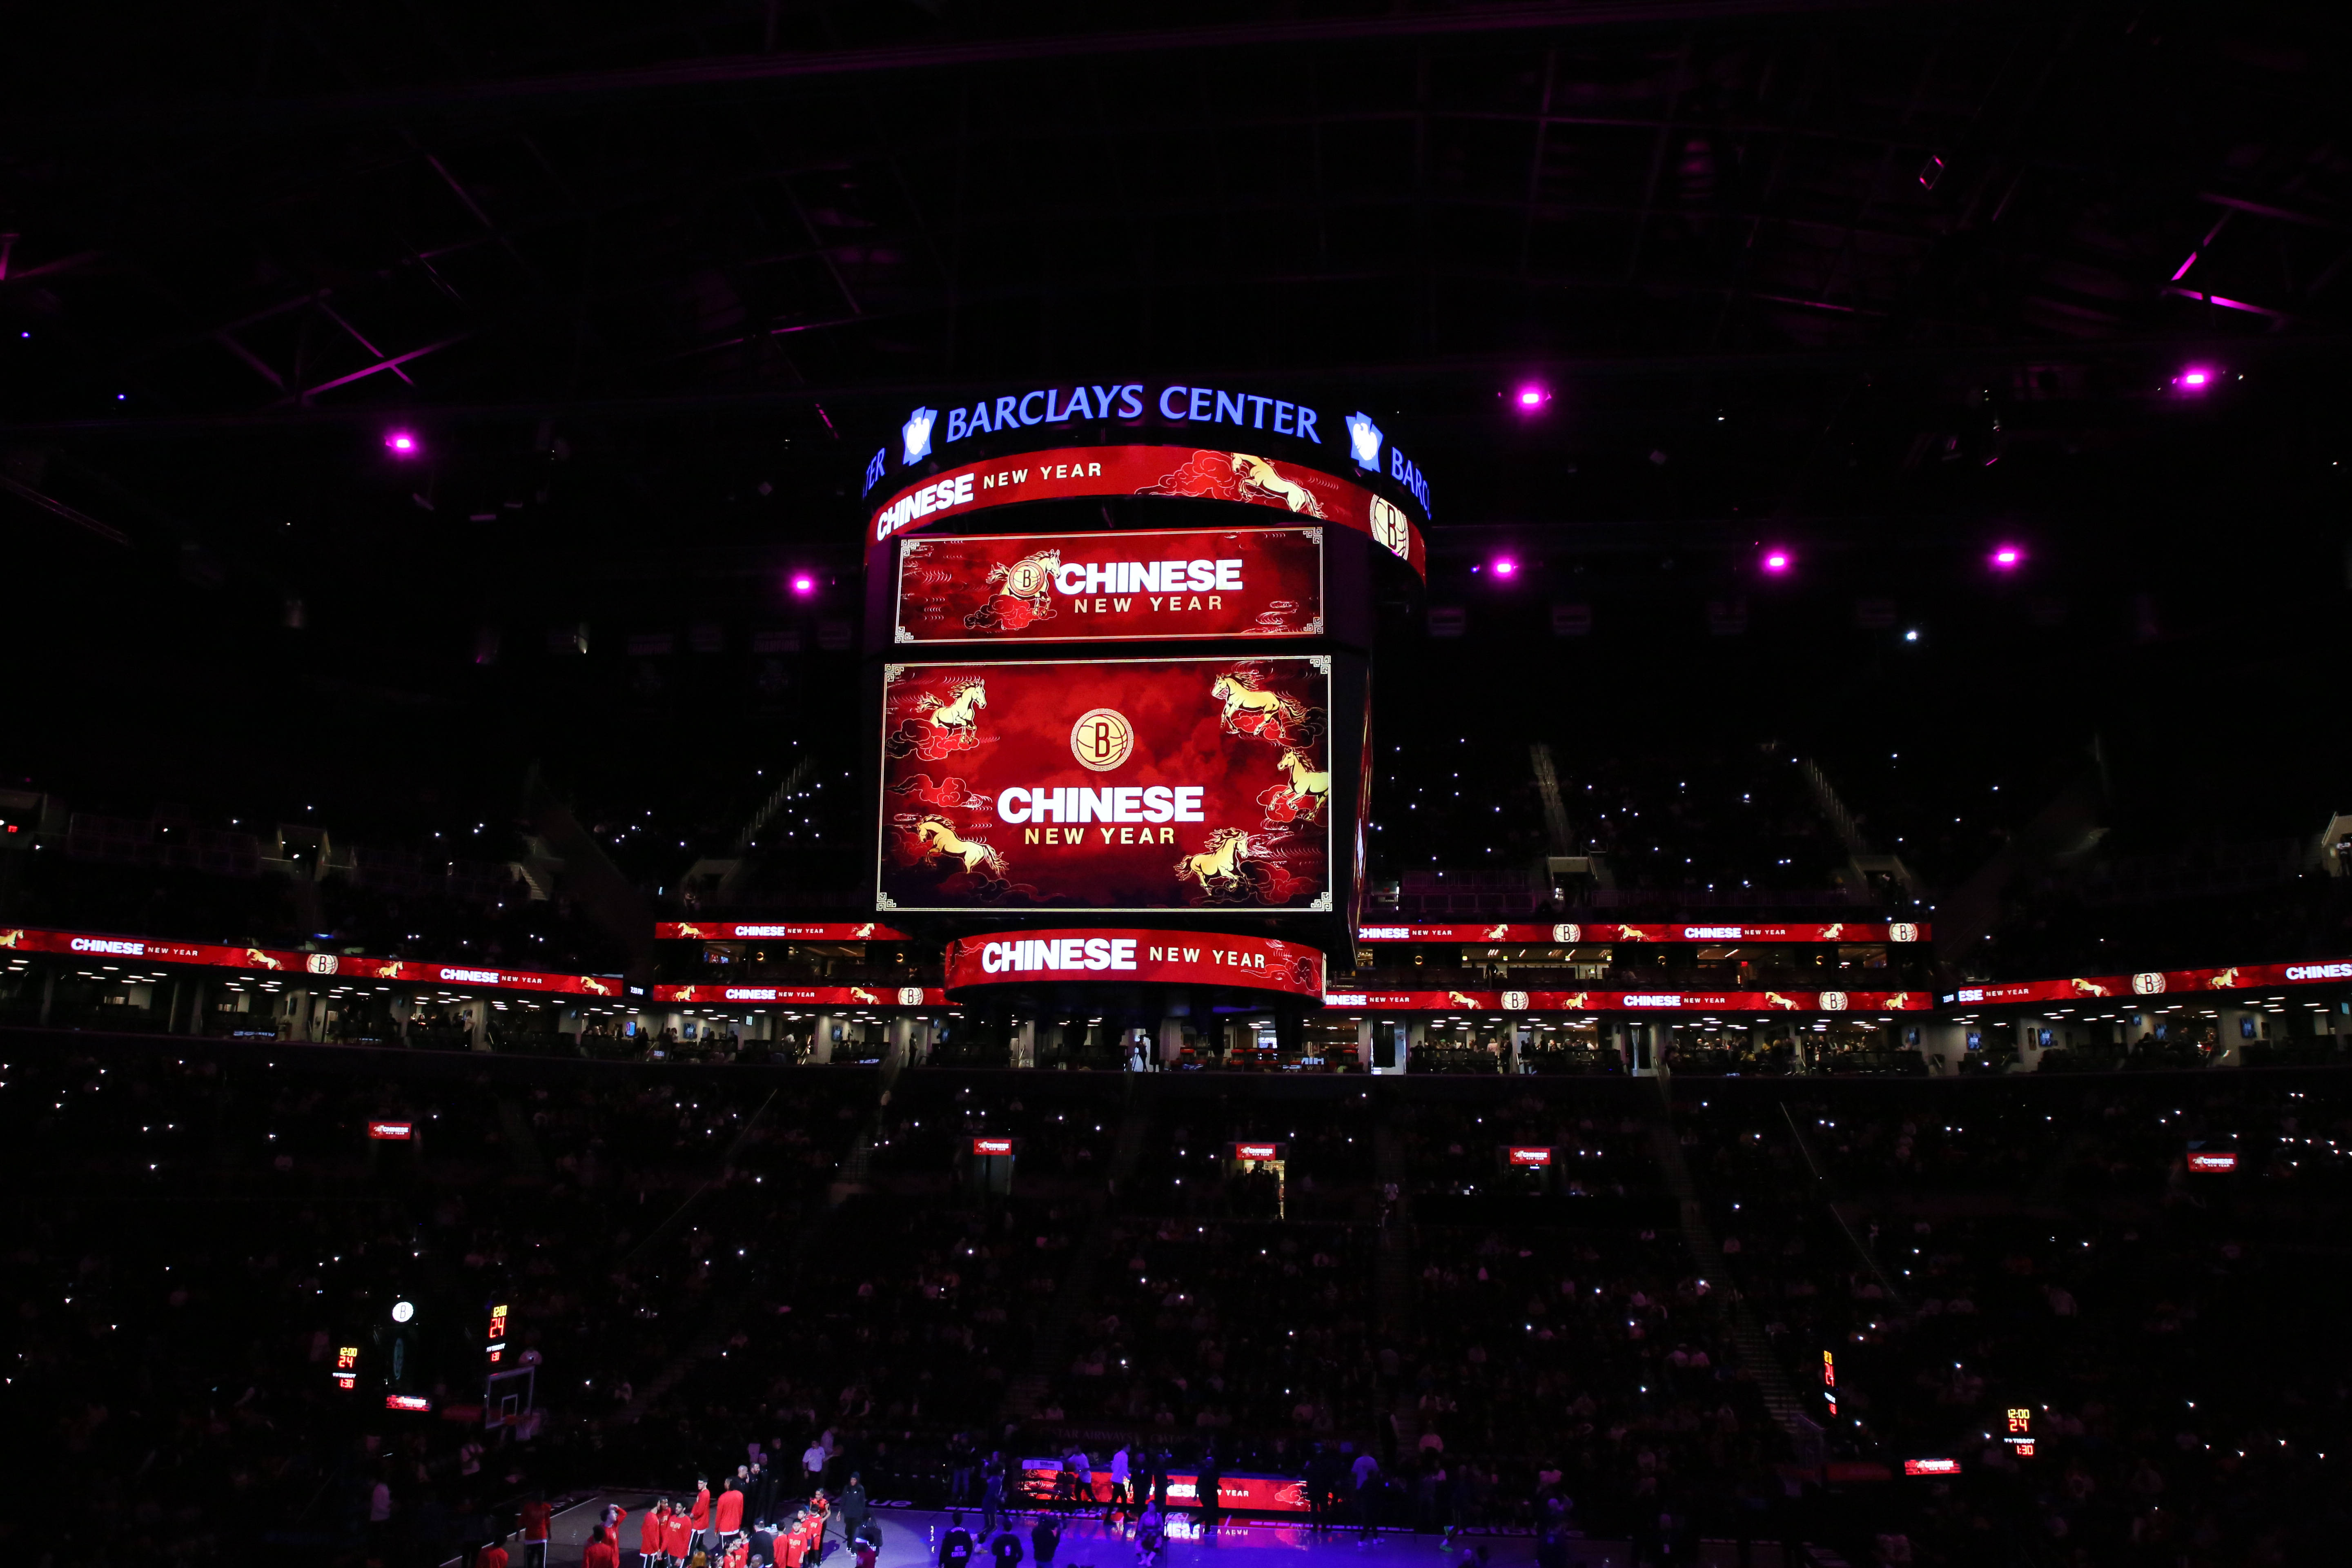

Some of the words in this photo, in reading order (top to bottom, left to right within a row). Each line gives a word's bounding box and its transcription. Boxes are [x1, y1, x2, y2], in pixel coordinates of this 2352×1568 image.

[946, 384, 1144, 443] BARCLAYS
[1159, 385, 1322, 444] CENTER
[877, 472, 976, 542] CHINESE
[984, 469, 1028, 489] NEW
[1040, 463, 1101, 480] YEAR
[1055, 559, 1243, 596] CHINESE
[1075, 598, 1132, 613] NEW
[1149, 595, 1221, 612] YEAR
[997, 786, 1205, 824] CHINESE
[1025, 828, 1085, 844] NEW
[1100, 827, 1174, 844] YEAR
[735, 926, 785, 936] CHINESE
[1684, 927, 1742, 938] CHINESE
[71, 938, 144, 955] CHINESE
[982, 938, 1137, 973] CHINESE
[1149, 947, 1200, 962] NEW
[1212, 950, 1265, 969] YEAR
[440, 968, 499, 983] CHINESE
[2285, 963, 2352, 980] CHINES
[726, 989, 777, 1000] CHINESE
[1624, 995, 1681, 1006] CHINESE
[490, 1317, 505, 1338] 24
[340, 1347, 358, 1357] 12:00
[339, 1356, 354, 1368] 24
[340, 1379, 354, 1388] 1:30
[2008, 1409, 2030, 1419] 12:00
[2009, 1419, 2027, 1432] 24
[2017, 1445, 2034, 1455] 1:30
